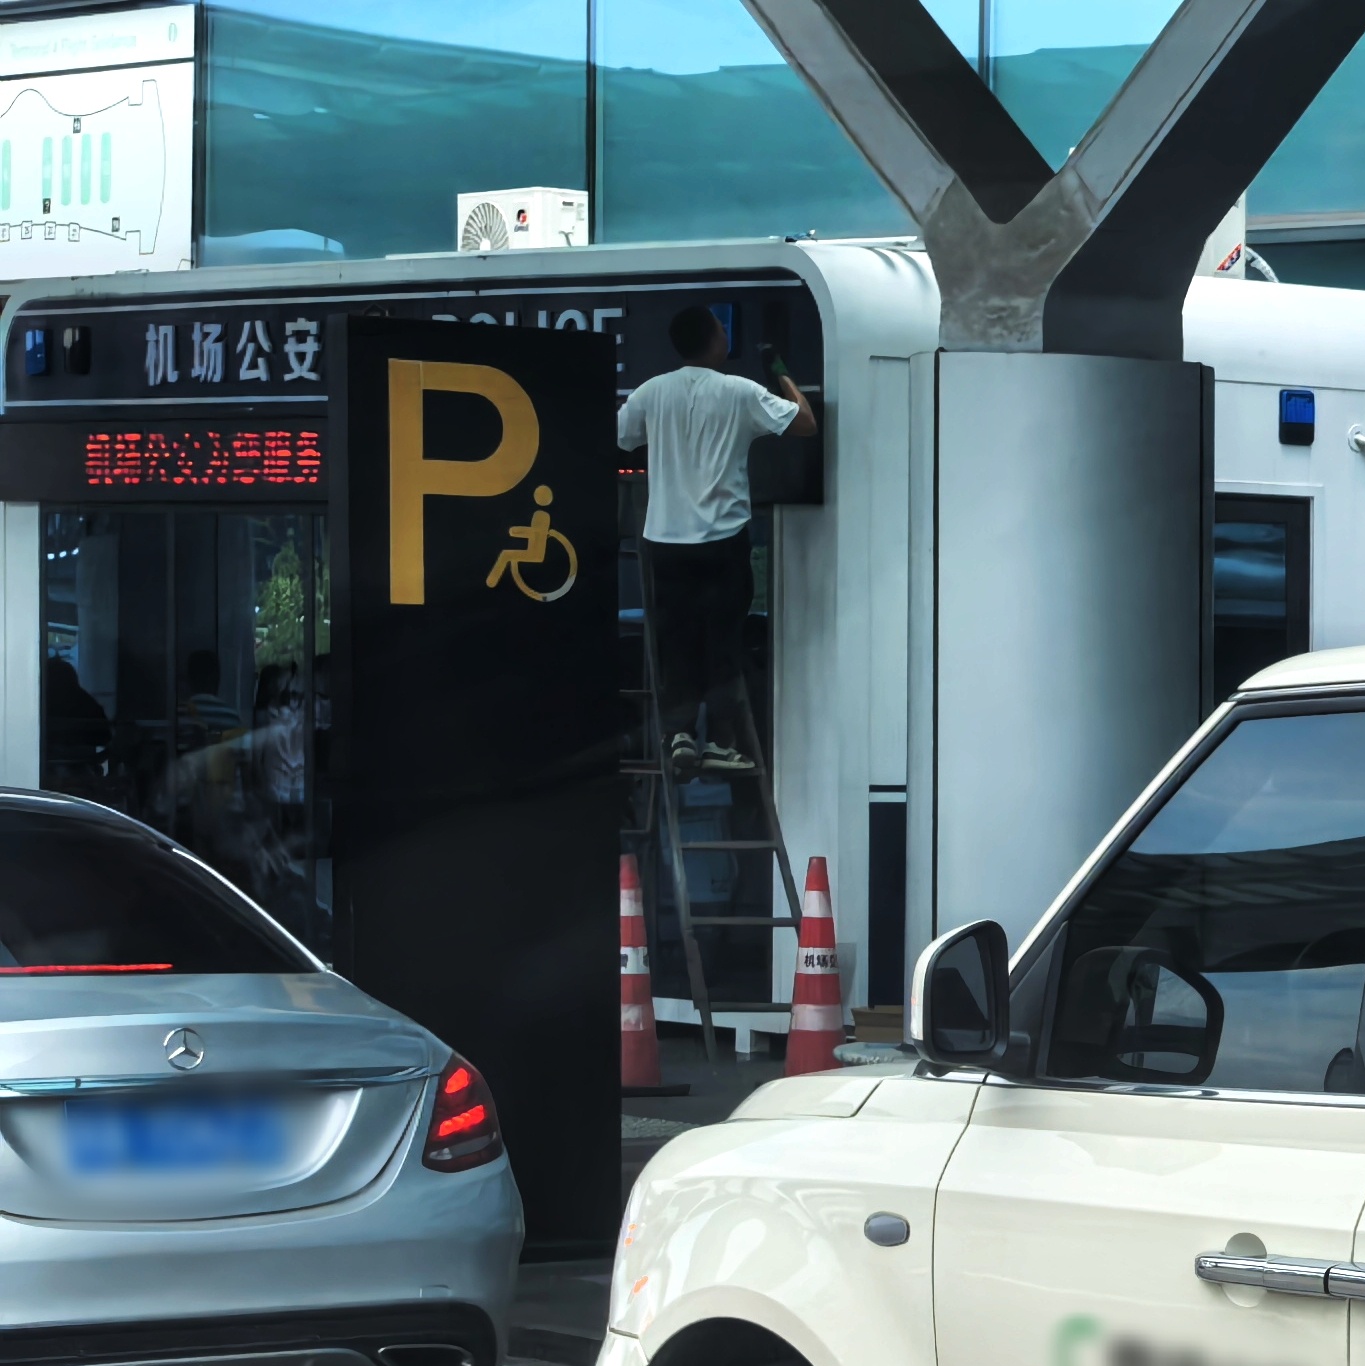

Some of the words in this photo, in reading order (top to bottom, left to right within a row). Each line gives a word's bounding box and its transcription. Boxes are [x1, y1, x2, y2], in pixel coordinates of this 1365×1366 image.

[145, 317, 321, 386] 机场公安
[388, 358, 540, 605] P
